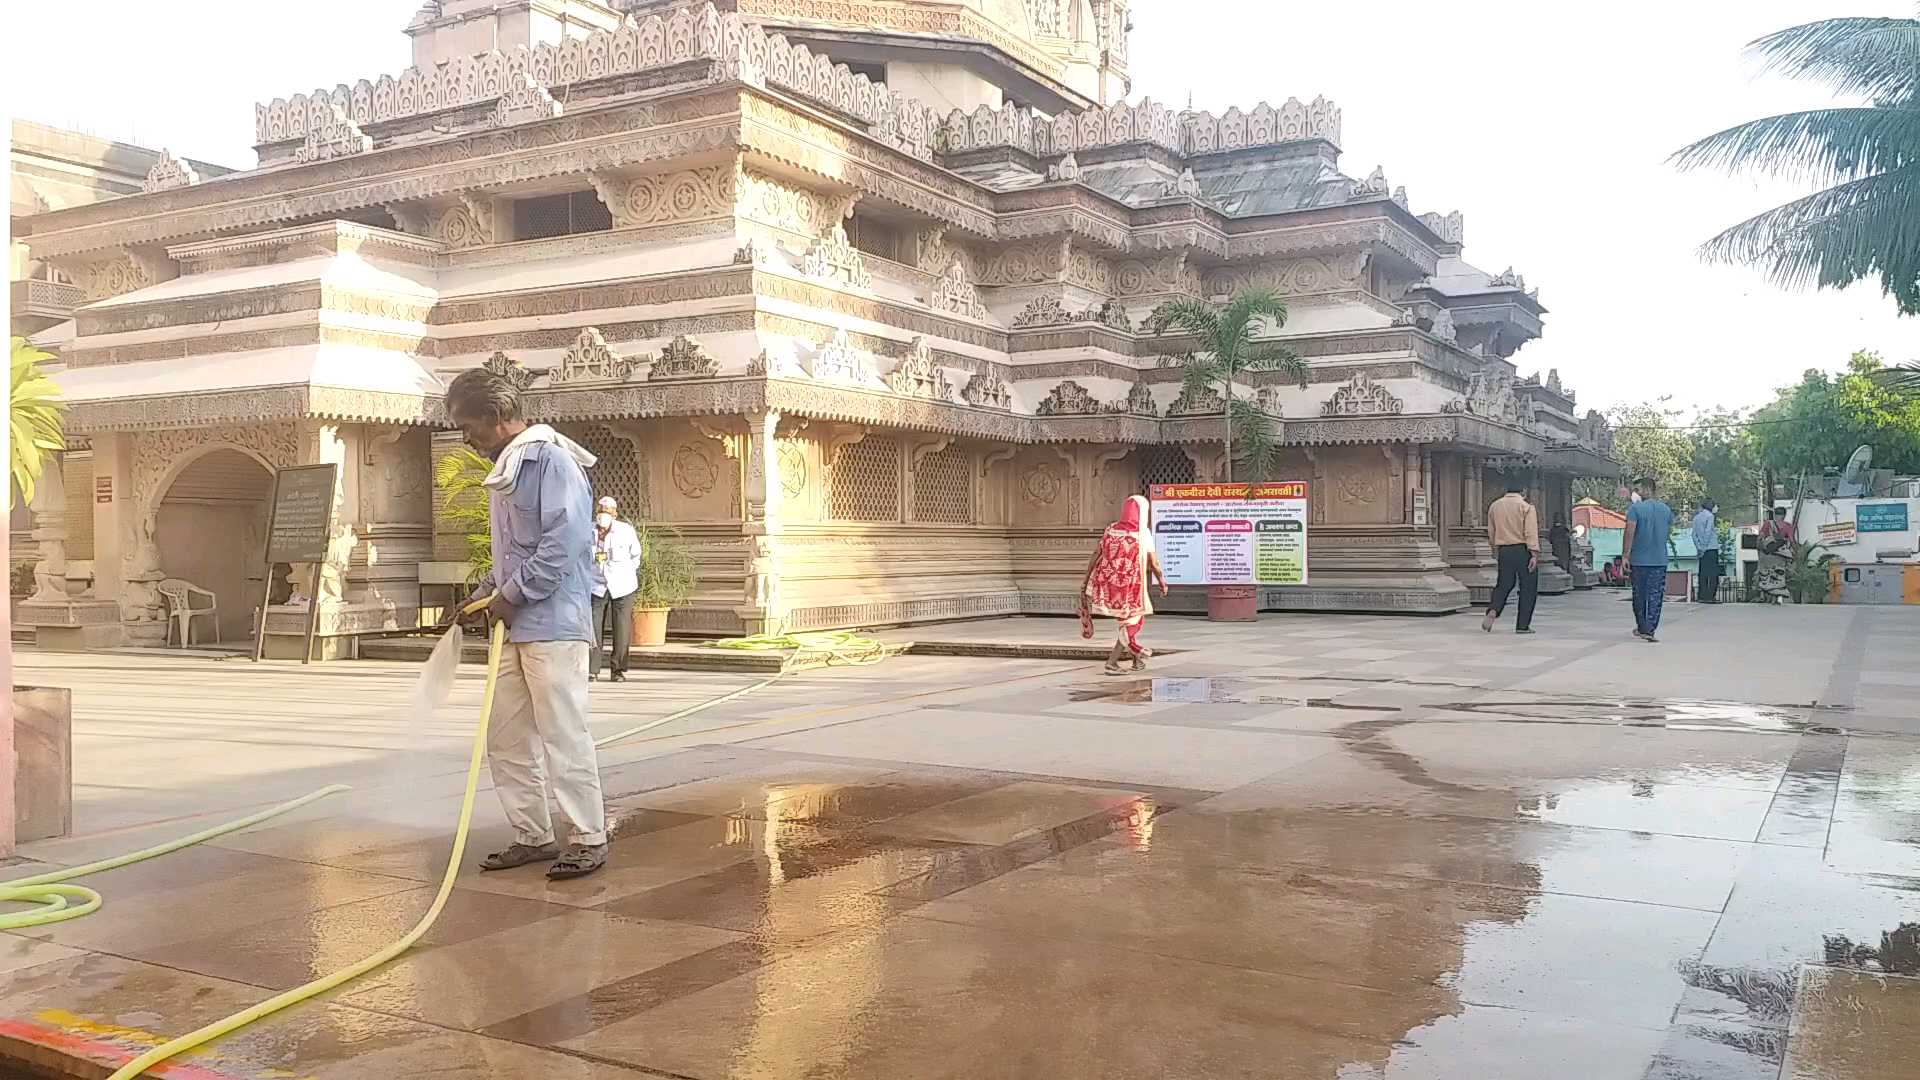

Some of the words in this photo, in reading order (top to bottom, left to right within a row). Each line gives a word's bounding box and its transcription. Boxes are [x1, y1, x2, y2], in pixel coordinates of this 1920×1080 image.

[1165, 487, 1174, 497] श्री
[1176, 487, 1206, 498] एकवीरा
[1207, 486, 1222, 498] देवी
